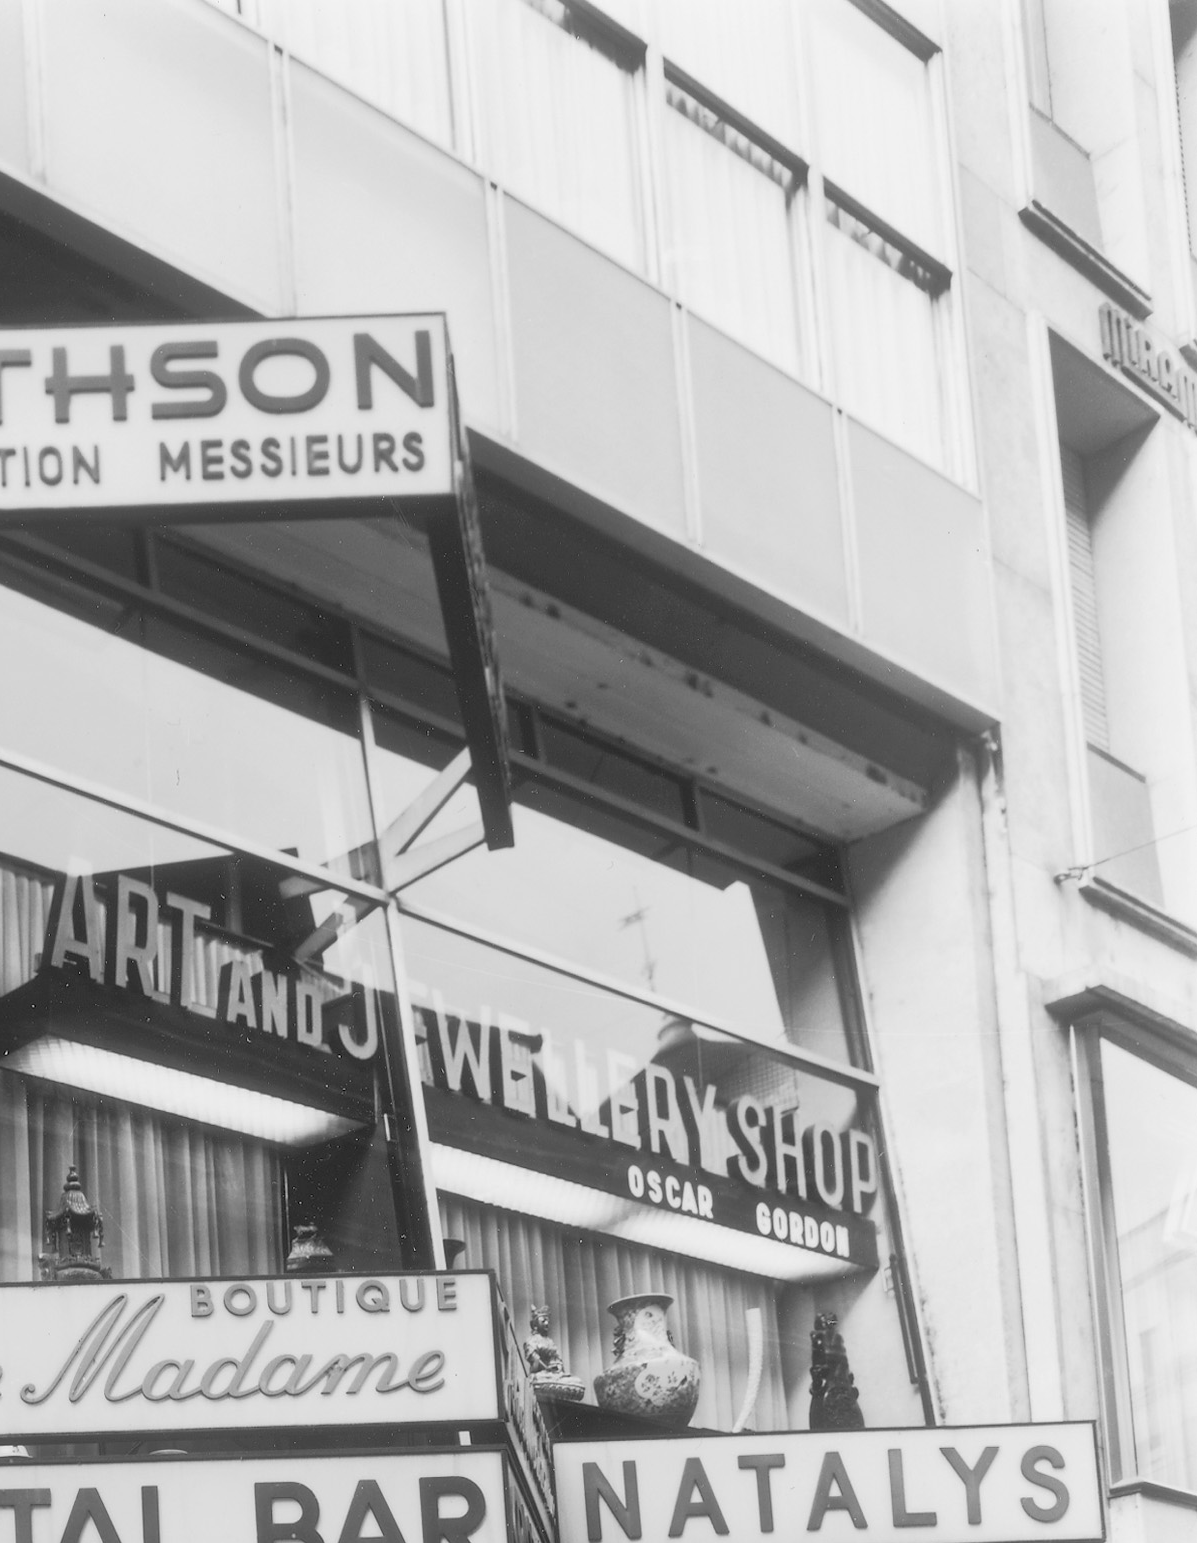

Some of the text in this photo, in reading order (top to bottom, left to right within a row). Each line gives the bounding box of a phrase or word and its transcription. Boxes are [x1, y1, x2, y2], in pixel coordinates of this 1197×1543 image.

[158, 431, 426, 482] MESSIEURS
[51, 857, 211, 1006] ART
[227, 960, 323, 1047] AND
[737, 1095, 878, 1215] SHOP
[627, 1165, 850, 1258] OSCAR GORDON
[190, 1277, 460, 1318] BOUTIQUE
[19, 1292, 446, 1404] Madame
[581, 1444, 1071, 1543] NATALYS
